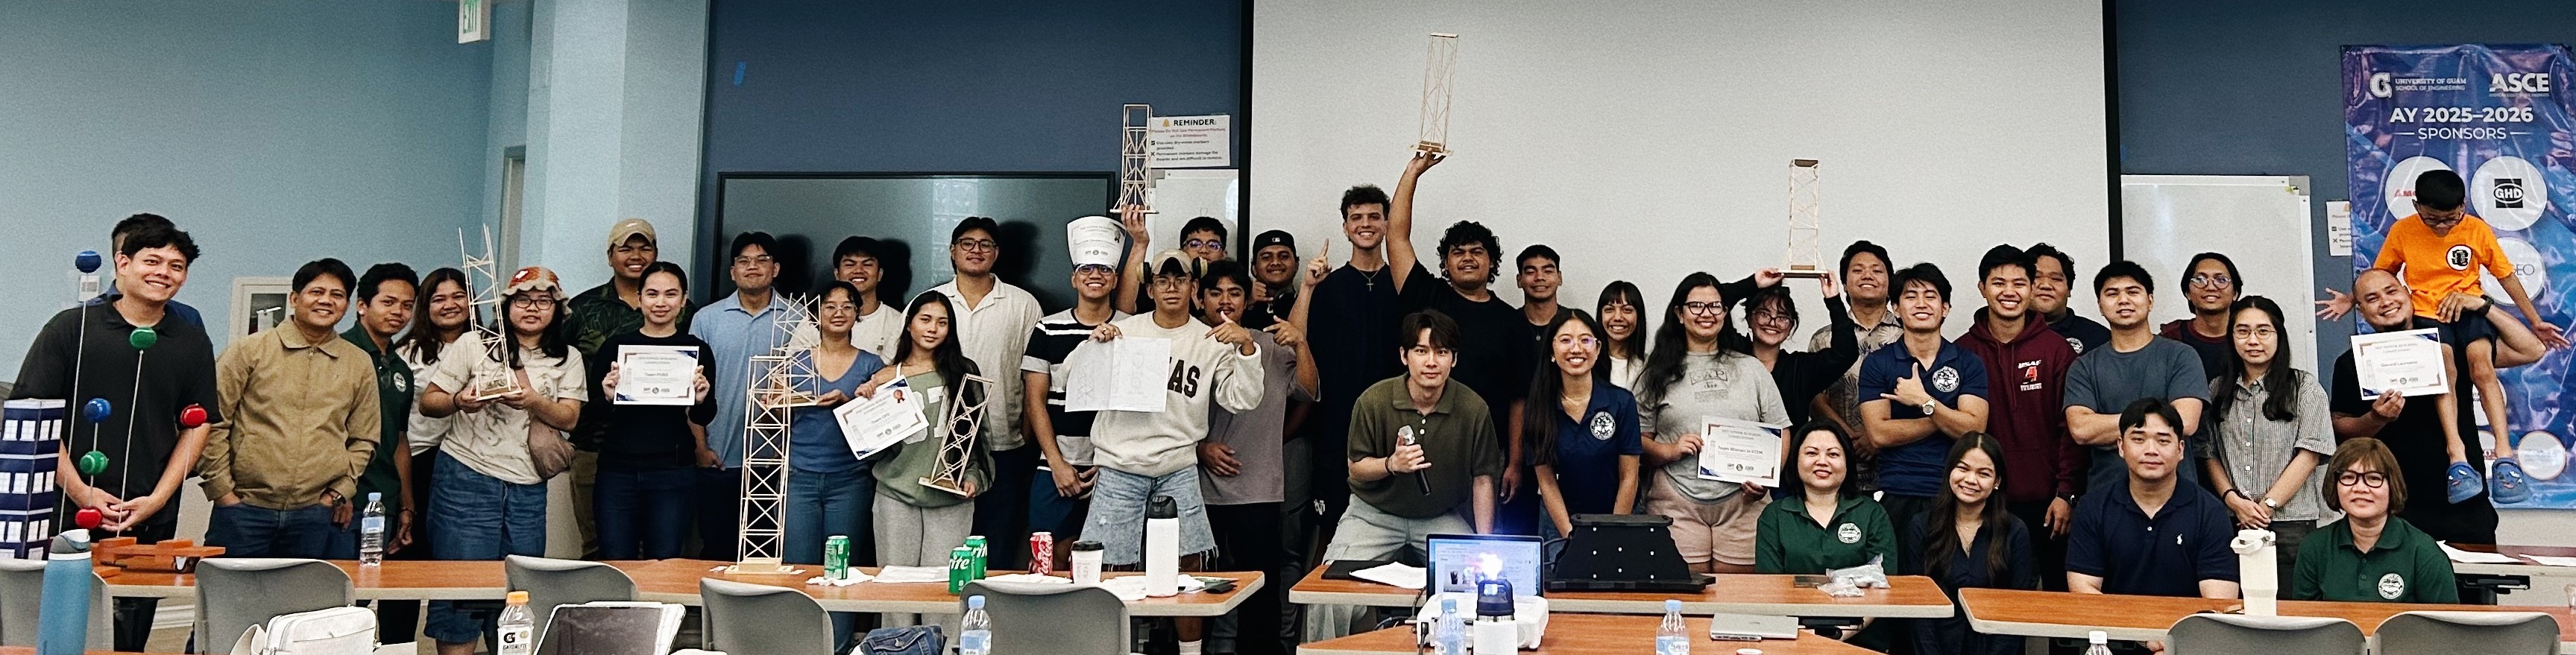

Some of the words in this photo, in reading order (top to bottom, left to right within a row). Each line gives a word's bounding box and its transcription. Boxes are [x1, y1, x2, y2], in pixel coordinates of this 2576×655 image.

[2489, 72, 2549, 92] ASCE
[2390, 107, 2418, 123] AY
[2417, 127, 2507, 140] SPONSORS
[2495, 188, 2523, 199] GHD
[2515, 264, 2535, 276] EO
[1168, 357, 1200, 399] AS
